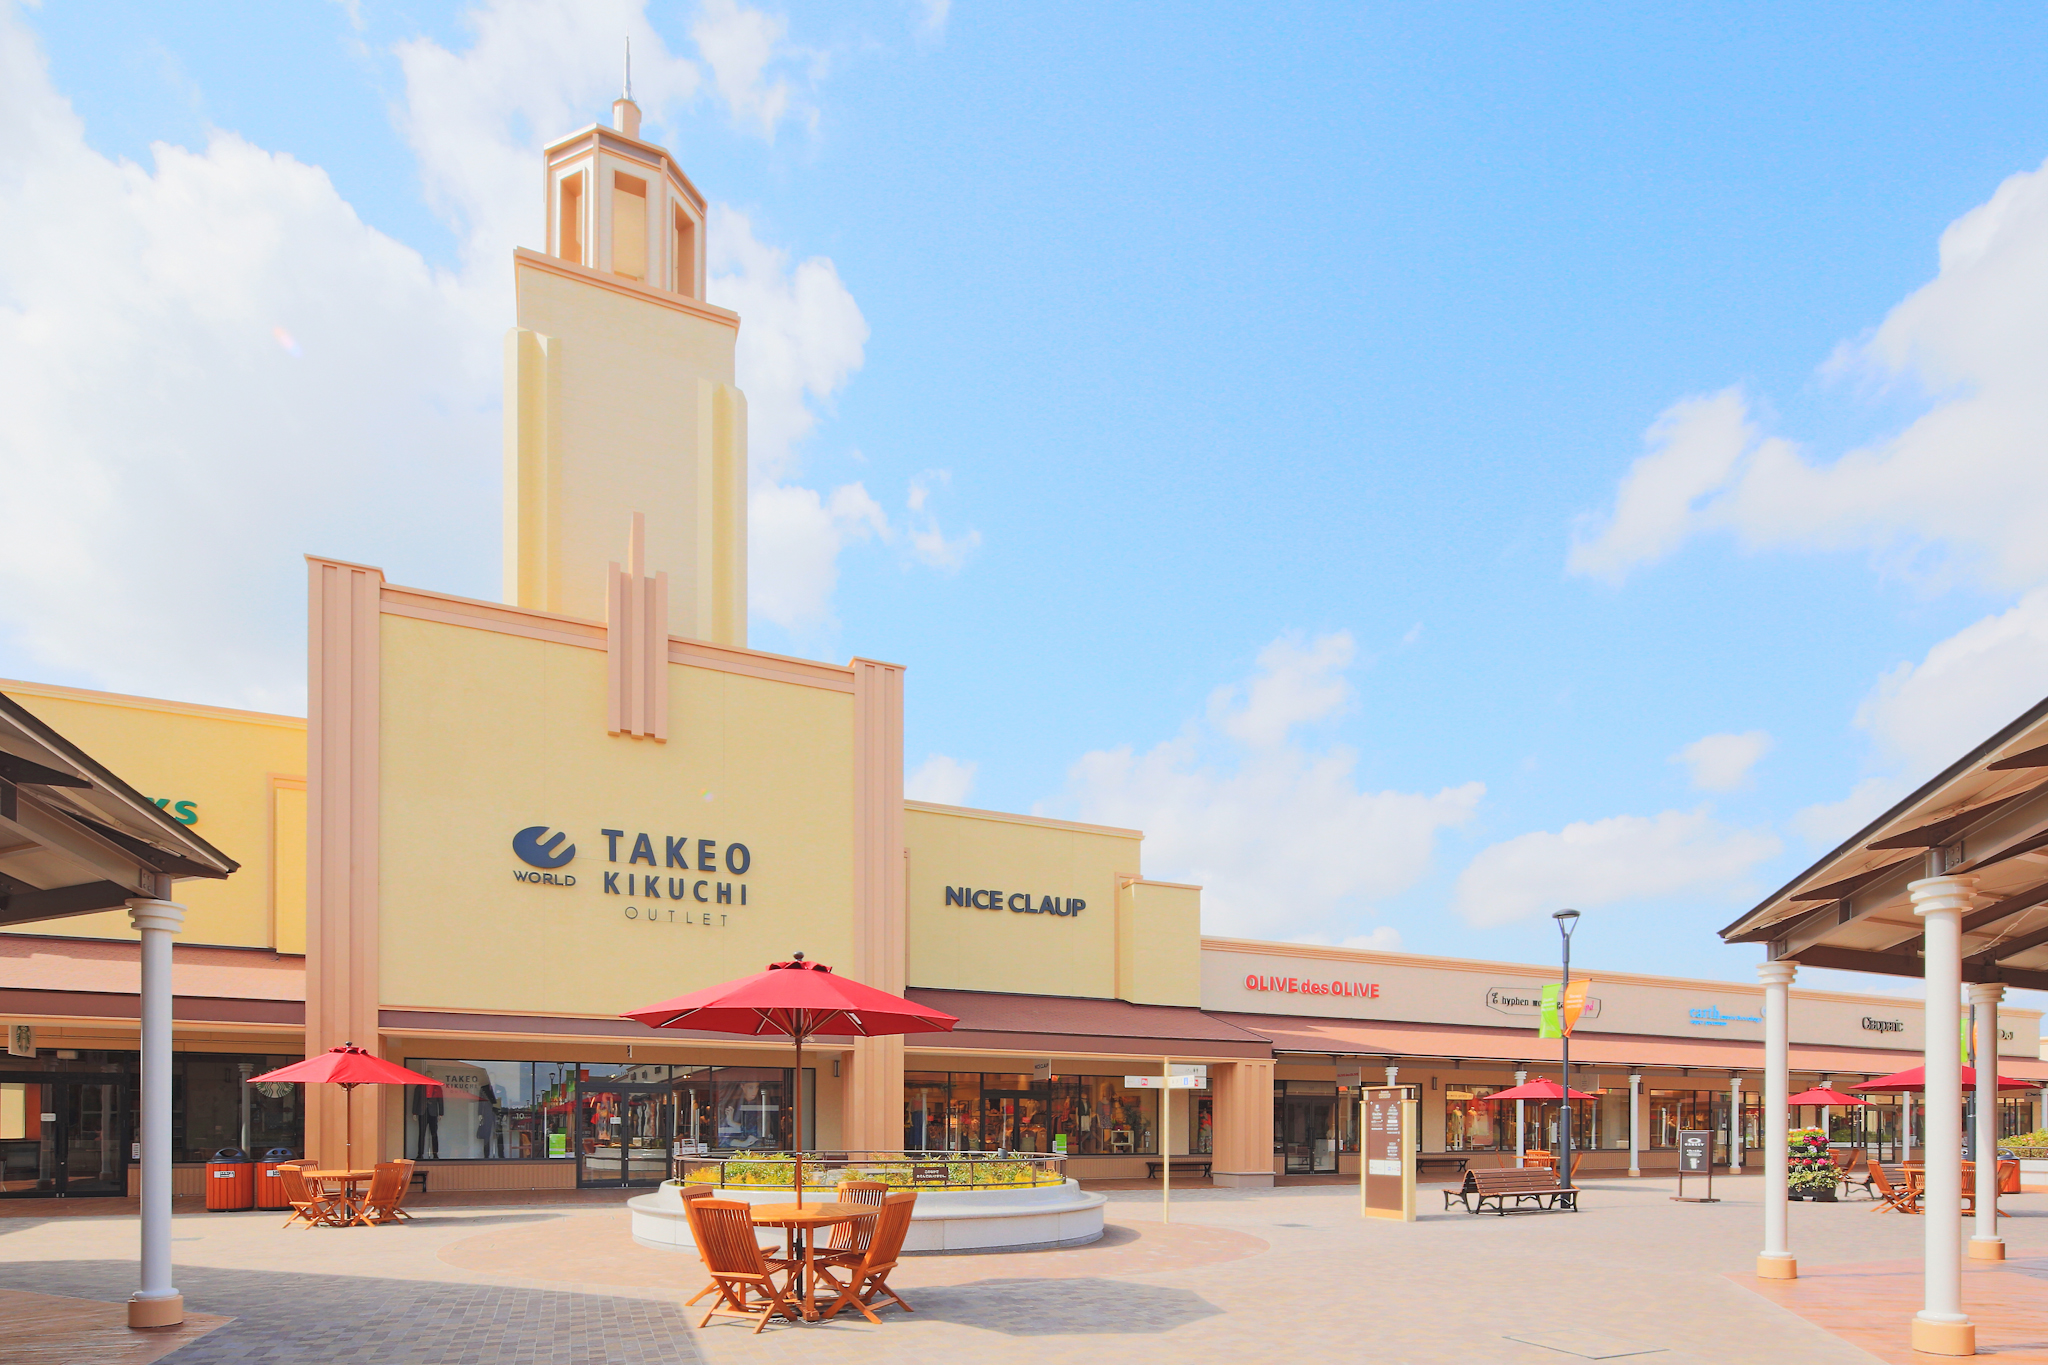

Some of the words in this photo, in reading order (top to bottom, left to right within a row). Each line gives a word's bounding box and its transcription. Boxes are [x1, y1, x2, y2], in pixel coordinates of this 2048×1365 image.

[601, 828, 751, 875] TAKEO
[513, 870, 576, 886] WORLD
[604, 871, 747, 905] KIKUCHI
[945, 885, 1003, 911] NICE
[1008, 892, 1087, 918] CLAUP
[625, 906, 728, 927] OUTLET
[1245, 974, 1299, 993] OLIVE
[1300, 978, 1329, 996] des
[1331, 980, 1380, 998] OLIVE
[1502, 996, 1529, 1007] hyphen
[1689, 1004, 1720, 1019] earth
[445, 1075, 478, 1083] TAKEO
